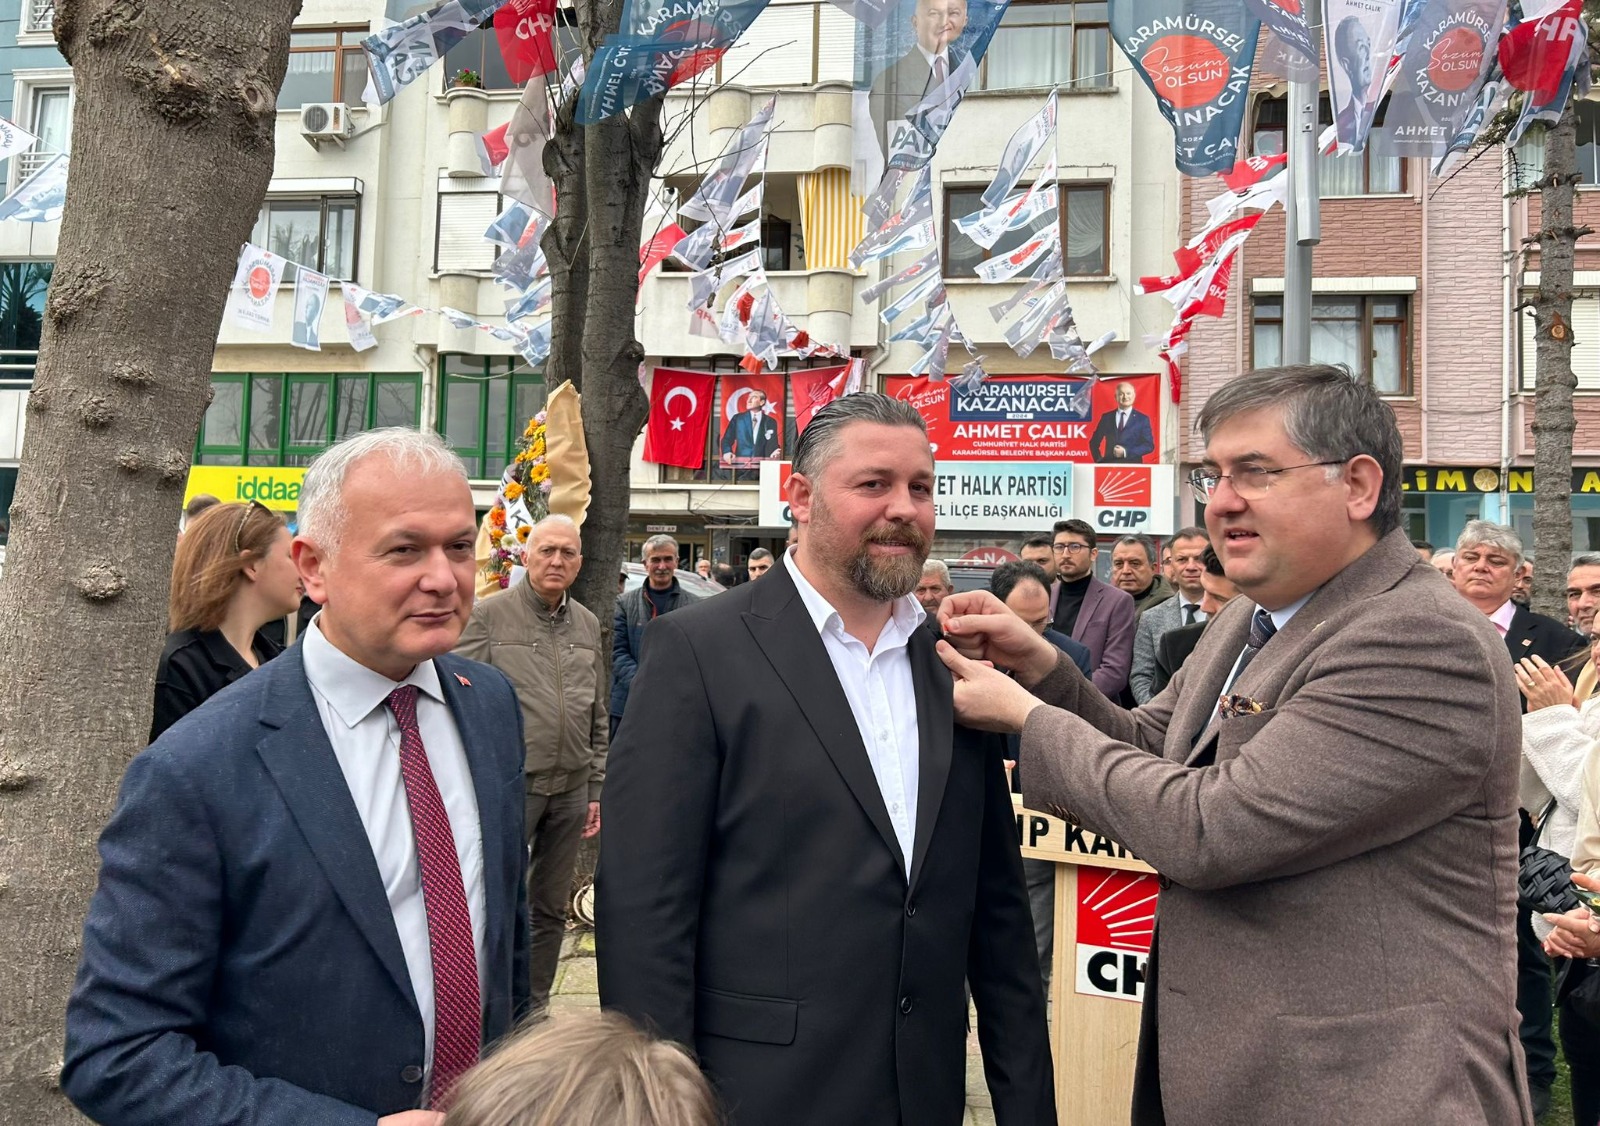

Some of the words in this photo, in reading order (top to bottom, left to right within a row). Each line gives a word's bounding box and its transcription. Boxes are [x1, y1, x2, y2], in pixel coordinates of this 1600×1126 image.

[515, 12, 553, 40] CHP
[1123, 13, 1245, 57] KARAMÜRSEL
[1423, 10, 1491, 50] KARAMÜRSE
[1441, 60, 1479, 72] OLSUN
[1165, 68, 1222, 88] OLSUN
[1395, 125, 1447, 136] AHMET
[912, 394, 945, 410] OLSUN
[953, 424, 1024, 439] AHMET
[1028, 424, 1088, 441] ÇALIK
[952, 448, 999, 457] KARAMÜRSEL
[1000, 448, 1035, 457] BELEDİYE
[1035, 450, 1065, 458] BAŞKAN
[972, 440, 1018, 448] CUMHURİYET
[1040, 440, 1067, 448] PARTİSİ
[961, 475, 1003, 496] HALK
[1007, 470, 1067, 497] PARTİSİ
[950, 502, 979, 520] İLÇE
[983, 502, 1063, 520] BAŞKANLIĞI
[1097, 509, 1148, 528] CHP
